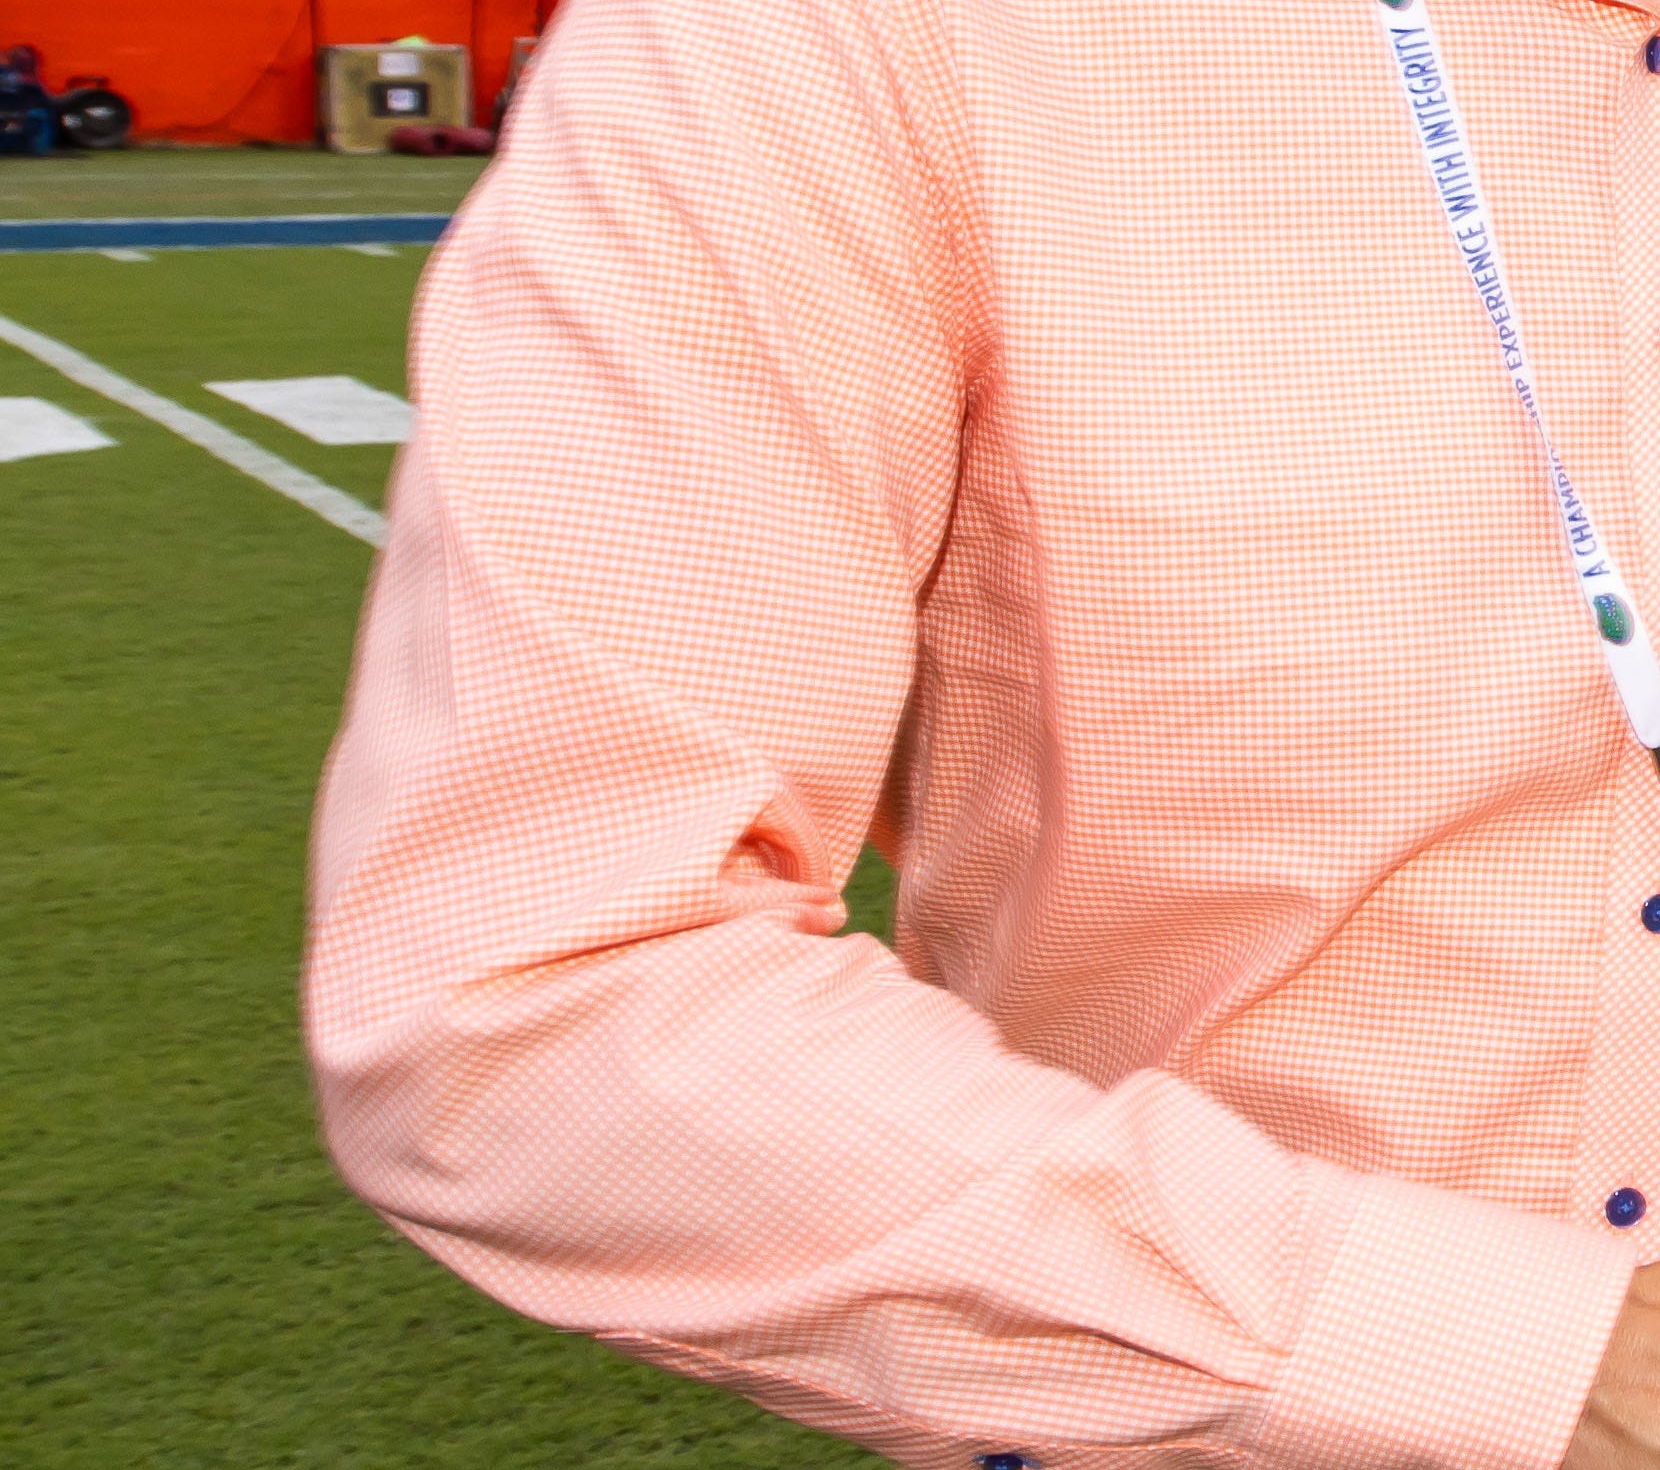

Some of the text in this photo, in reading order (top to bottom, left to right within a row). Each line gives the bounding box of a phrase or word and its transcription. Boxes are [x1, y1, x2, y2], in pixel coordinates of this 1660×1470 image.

[1389, 28, 1460, 150] INTEGRITY
[1431, 151, 1479, 222] WITH
[1456, 222, 1523, 371] EXPERIENCE
[1582, 559, 1610, 577] A
